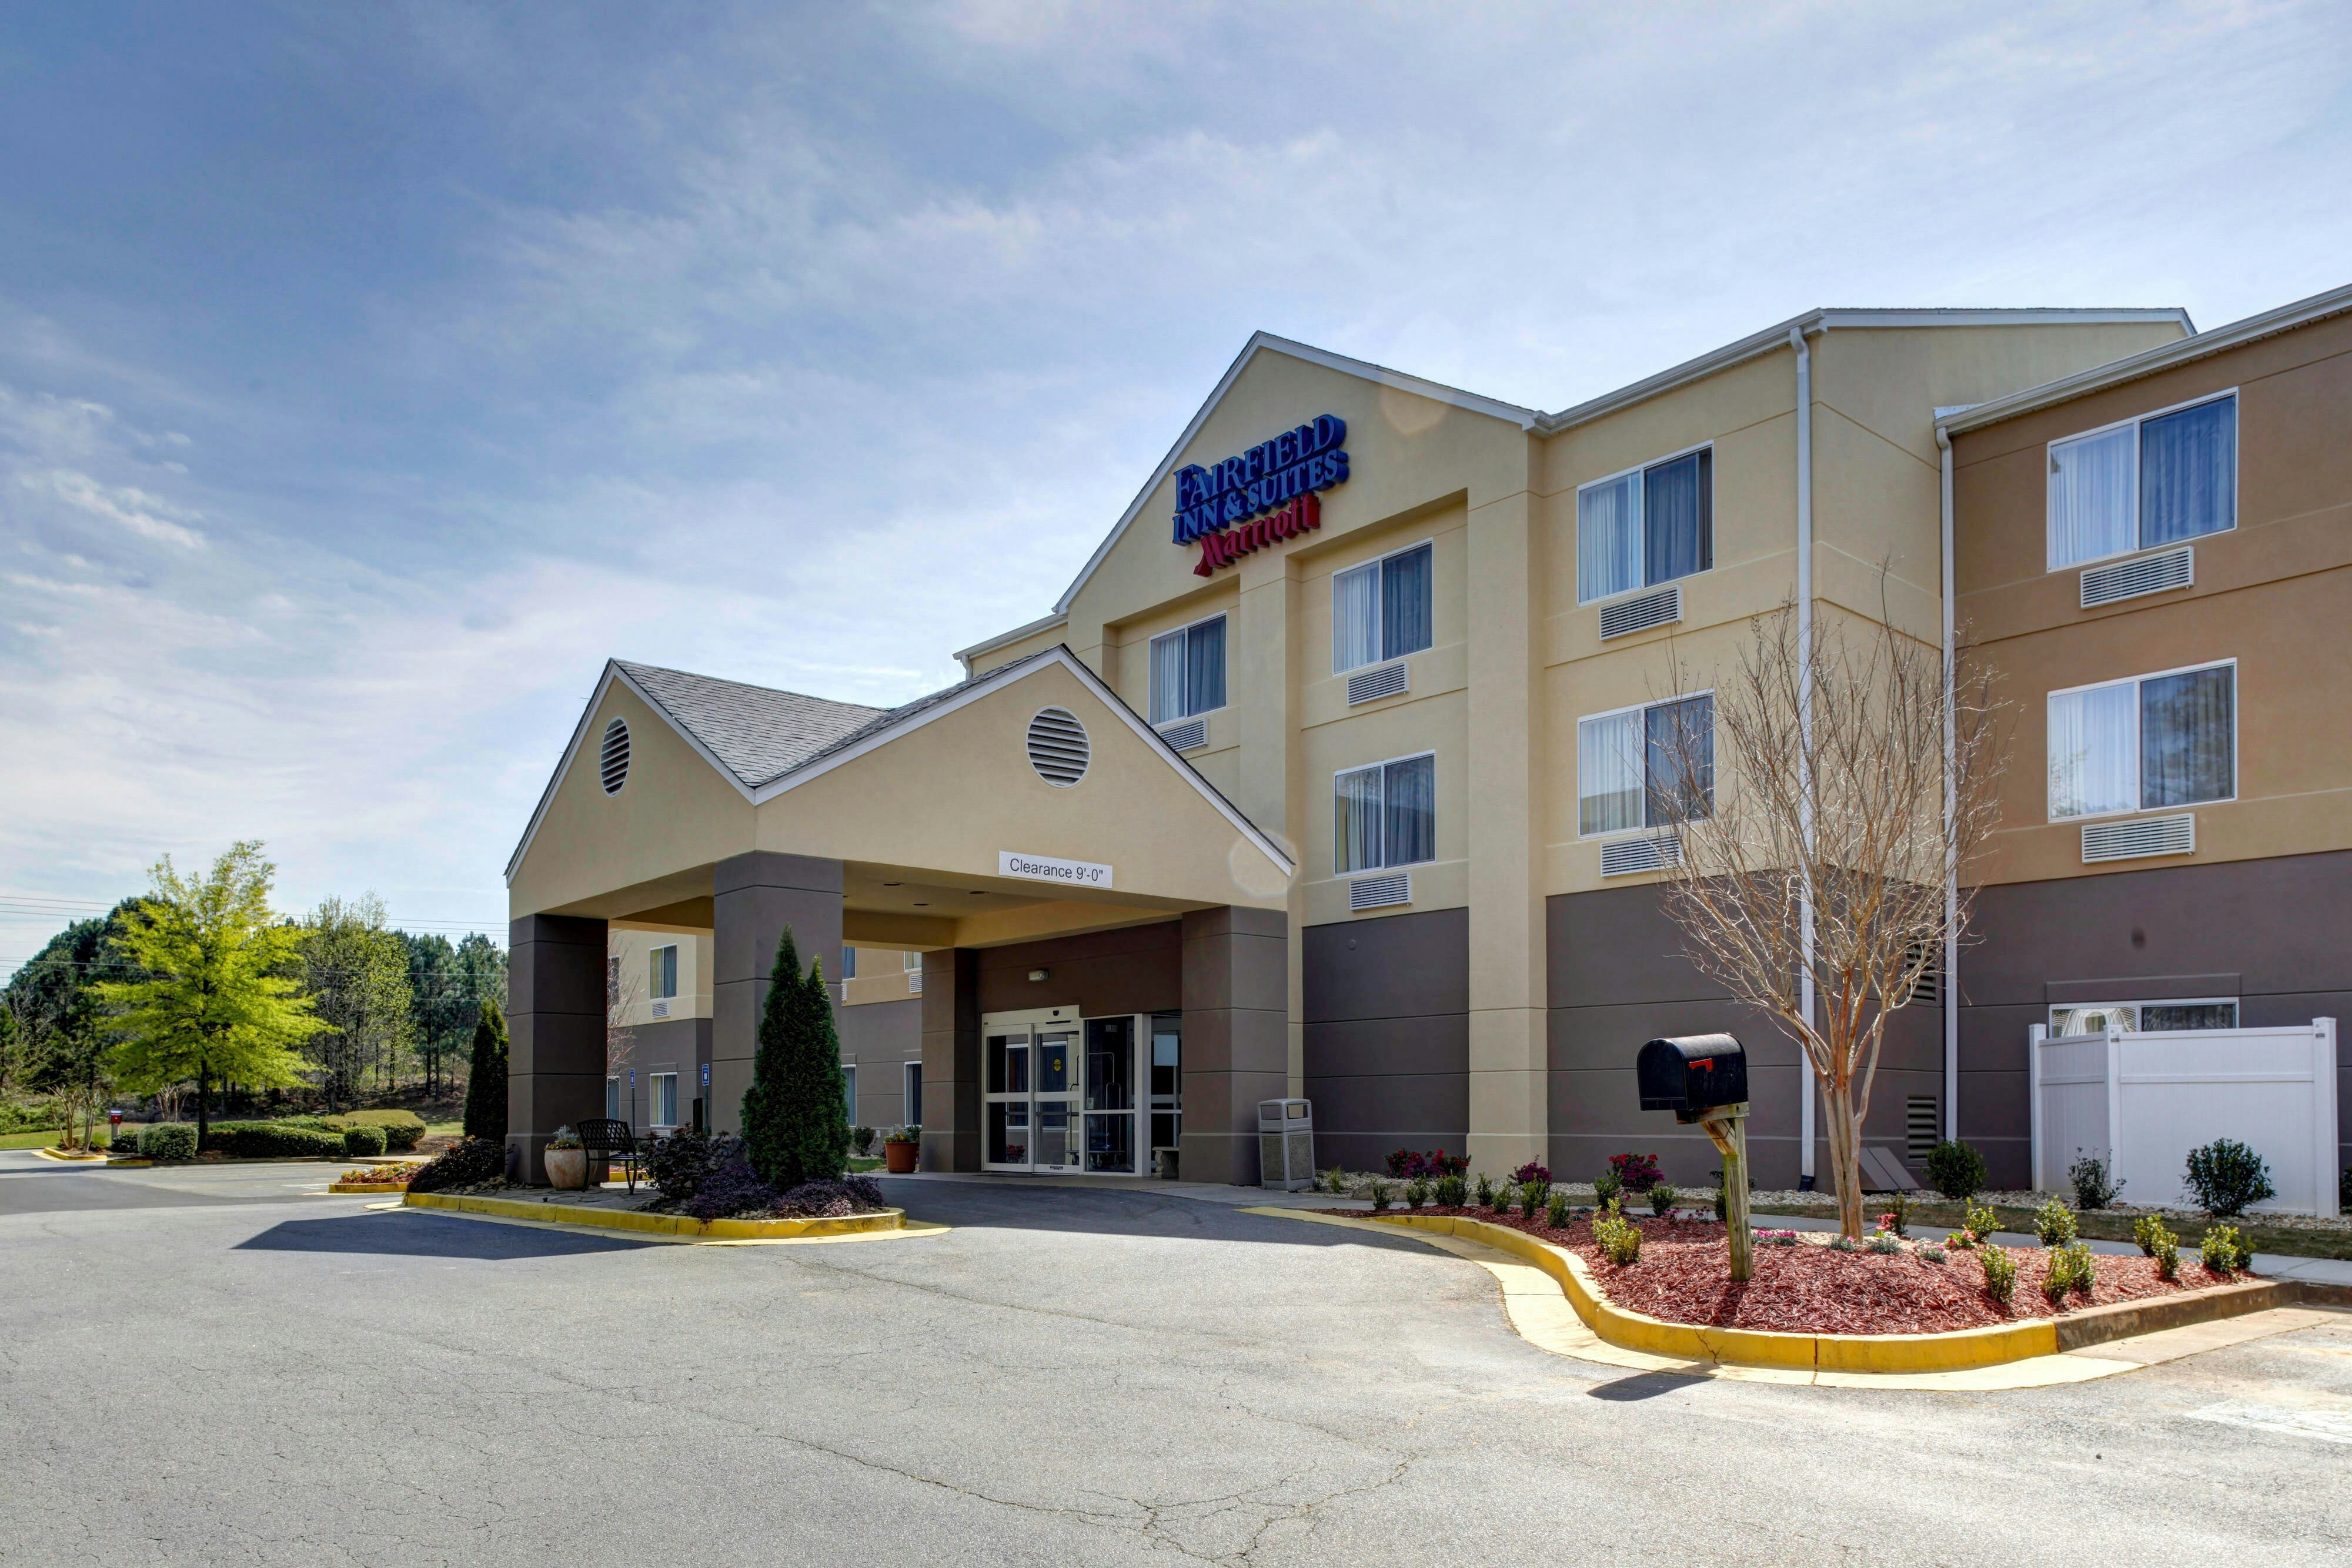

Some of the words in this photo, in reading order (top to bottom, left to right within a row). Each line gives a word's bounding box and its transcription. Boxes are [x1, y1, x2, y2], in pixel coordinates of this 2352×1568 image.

[1173, 414, 1346, 513] FAIRFIELD
[1193, 493, 1321, 577] Marriott
[1010, 858, 1072, 878] Clearance
[1077, 867, 1103, 881] 9'-0"
